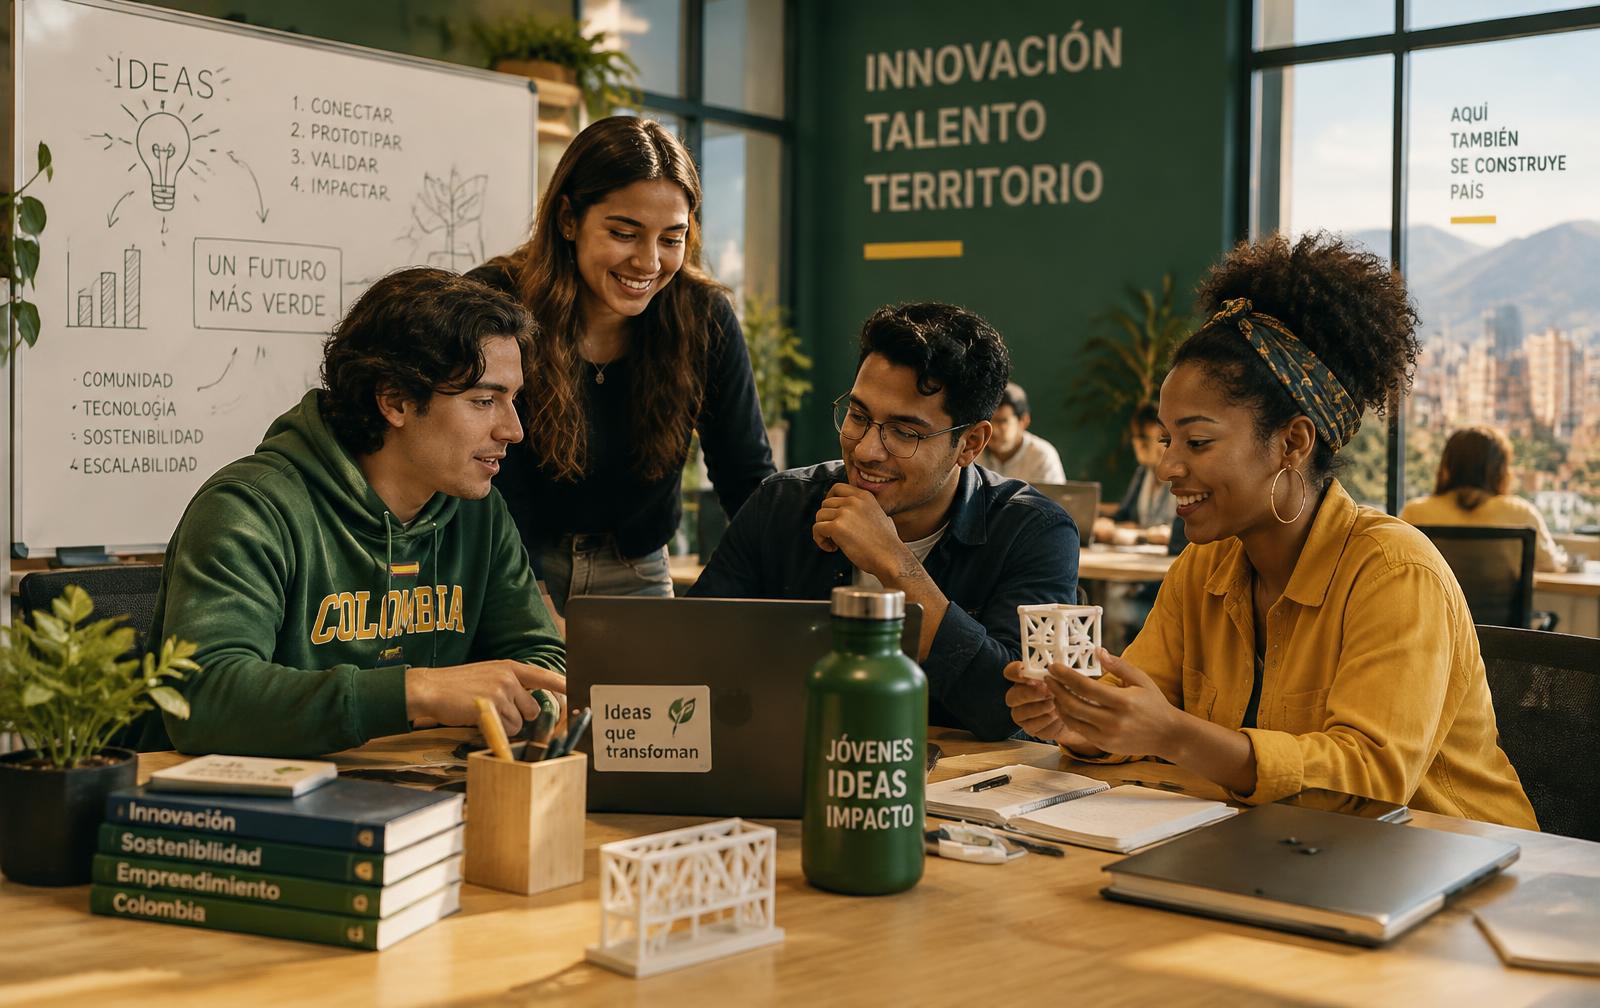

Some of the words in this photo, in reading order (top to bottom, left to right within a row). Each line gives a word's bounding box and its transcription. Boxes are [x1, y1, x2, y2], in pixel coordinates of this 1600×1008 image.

[866, 20, 1122, 91] INNOVACIÓN
[114, 58, 214, 99] IDEAS
[294, 95, 304, 111] 1.
[311, 97, 394, 123] CONECTAR
[1450, 101, 1488, 124] AQUÍ
[291, 122, 305, 138] 2.
[311, 123, 402, 151] PROTOTIPAR
[865, 100, 1046, 151] TALENTO
[1450, 126, 1518, 148] TAMBIÉN
[291, 148, 305, 165] 3.
[311, 151, 378, 173] VALIDAR
[1450, 158, 1469, 174] SE
[1475, 155, 1567, 173] CONSTRUYE
[290, 176, 305, 193] 4.
[312, 178, 391, 202] IMPACTAR
[864, 160, 1104, 212] TERRITORIO
[1450, 179, 1485, 200] PAÍS
[208, 254, 236, 276] UN
[248, 256, 326, 281] FUTURO
[209, 283, 253, 313] MÁS
[262, 292, 326, 316] VERDE
[82, 371, 173, 388] COMUNIDAD
[83, 429, 204, 445] SOSTENIBILIDAD
[83, 456, 198, 474] ESCALABILIDAD
[311, 584, 465, 645] COLOMBIA
[605, 704, 652, 720] Ideas
[605, 728, 636, 743] que
[825, 733, 914, 763] JÓVENES
[828, 768, 907, 799] IDEAS
[129, 801, 236, 832] Innovación
[826, 803, 914, 831] IMPACTO
[116, 862, 281, 901] Emprendimiento
[112, 892, 206, 922] Colombia
